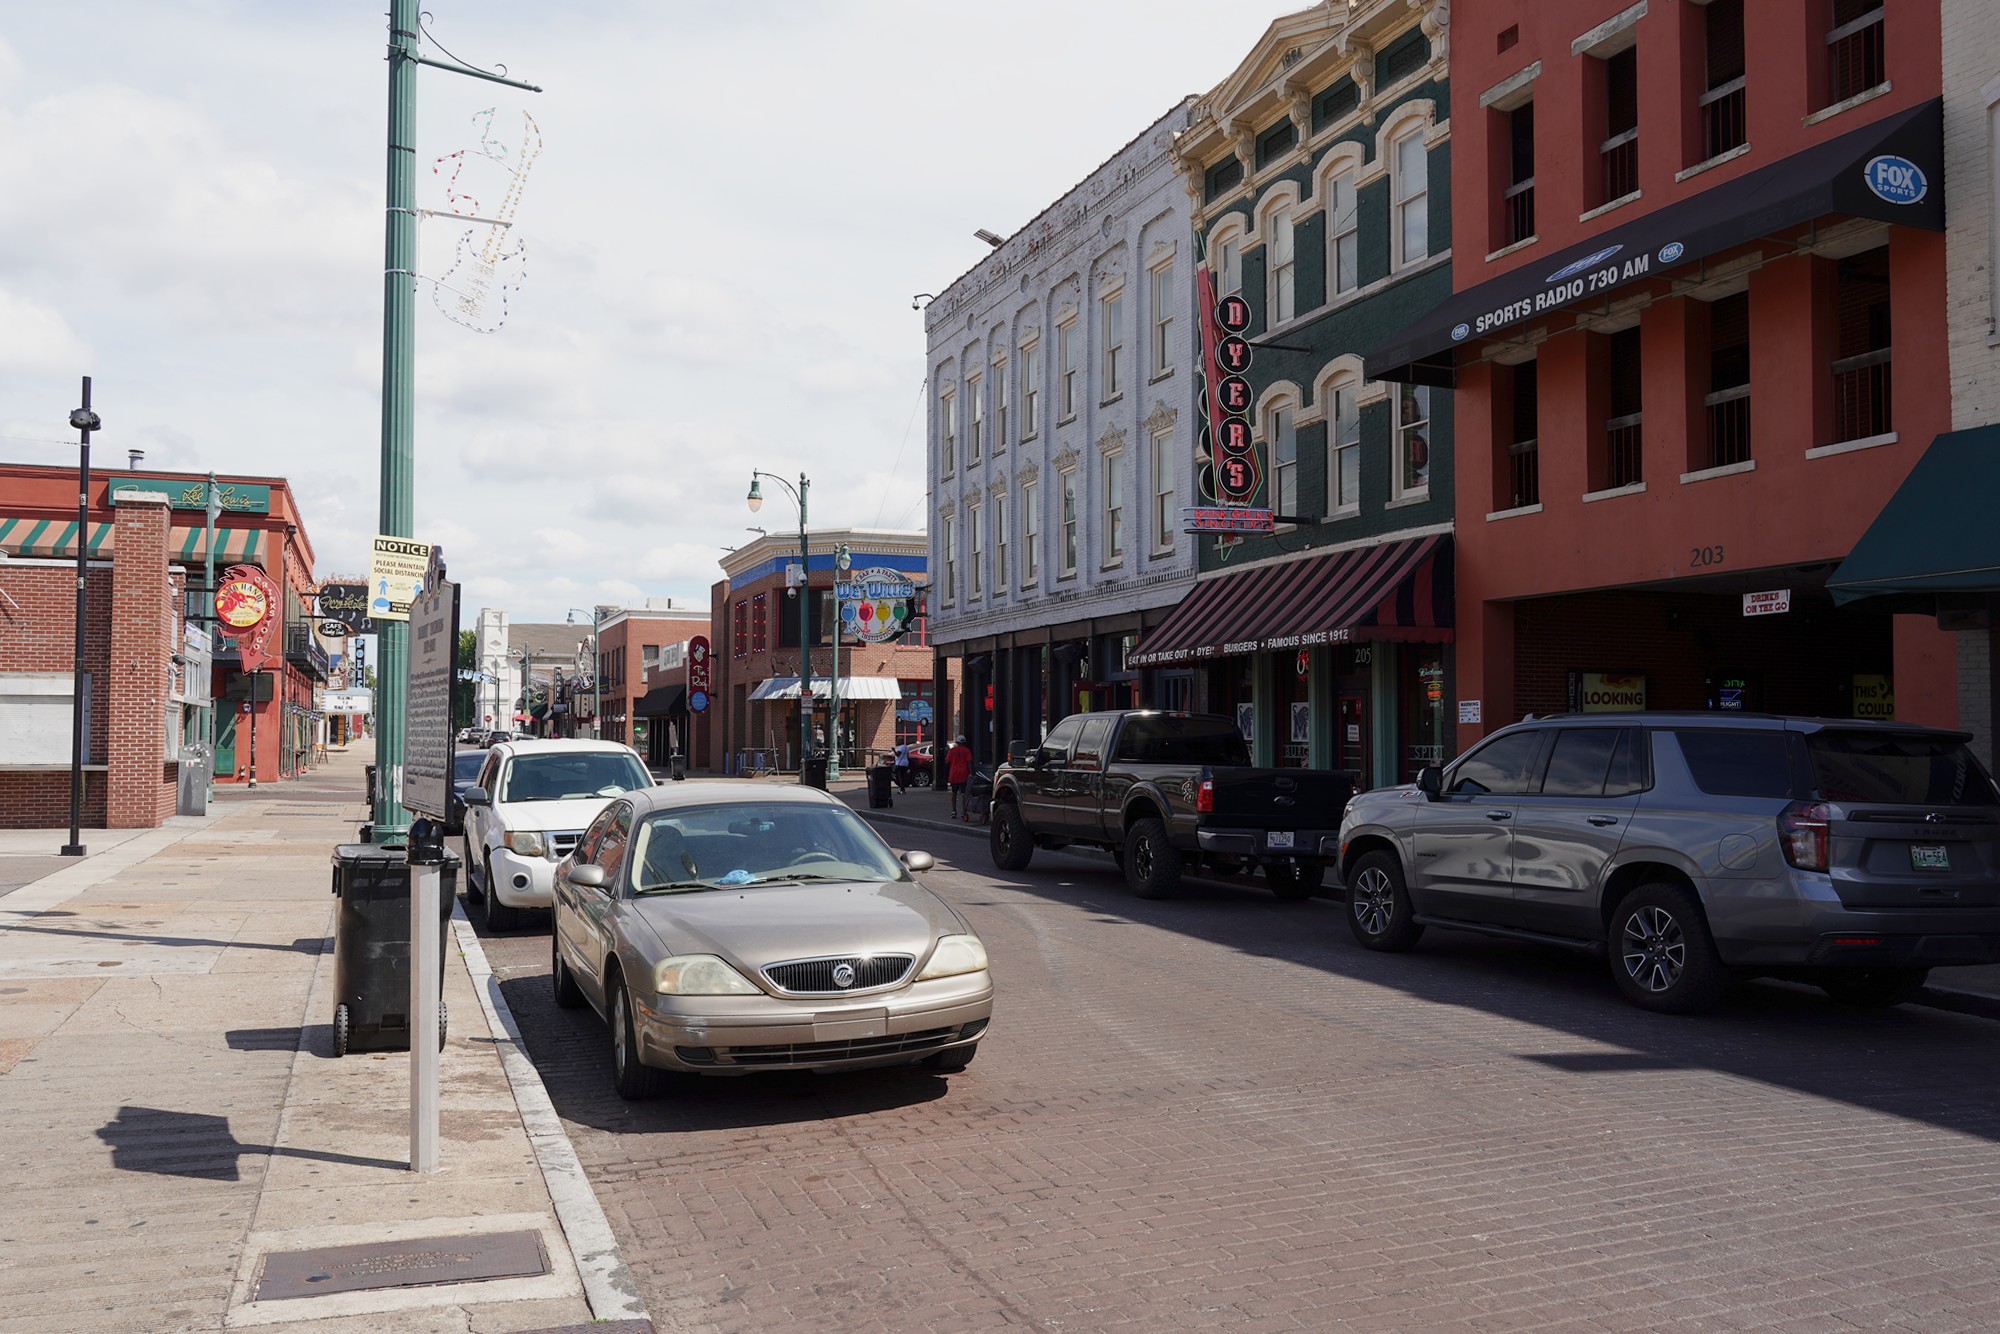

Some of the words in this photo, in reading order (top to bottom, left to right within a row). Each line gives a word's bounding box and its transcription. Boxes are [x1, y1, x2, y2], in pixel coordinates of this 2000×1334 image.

[1877, 162, 1915, 190] FOX
[1877, 184, 1916, 197] SPORTS
[1663, 244, 1678, 257] FOX
[1475, 298, 1531, 333] SPORTS
[1536, 279, 1584, 311] RADIO
[1588, 266, 1618, 291] 730
[1622, 253, 1649, 280] AM
[183, 483, 204, 507] Lee
[1195, 509, 1274, 520] BURGERS
[1196, 520, 1236, 529] SINCE
[1242, 520, 1275, 531] 1912
[376, 541, 428, 556] NOTICE
[1691, 545, 1724, 568] 203
[374, 567, 394, 575] SOCIAL
[376, 560, 397, 568] PLEASE
[398, 562, 425, 571] MAINTAIN
[254, 576, 277, 617] DRINKS
[836, 581, 865, 599] WET
[1751, 592, 1779, 603] DRINKS
[1746, 605, 1757, 614] ON
[1759, 603, 1774, 612] THE
[1775, 601, 1788, 611] GO
[861, 625, 896, 641] INSTITUTION
[1128, 655, 1139, 665] EAT
[1140, 654, 1147, 663] IN
[1148, 653, 1157, 662] OR
[1158, 650, 1174, 661] TAKE
[1174, 649, 1188, 659] OUT
[1224, 641, 1258, 653] BURGERS
[1267, 635, 1300, 649] FAMOUS
[1301, 632, 1326, 644] SINCE
[1328, 629, 1349, 640] 1912
[1355, 648, 1372, 664] 205
[691, 675, 708, 692] Roof
[1585, 692, 1643, 705] LOOKING
[1854, 686, 1877, 698] THIS
[1858, 703, 1894, 715] COULD
